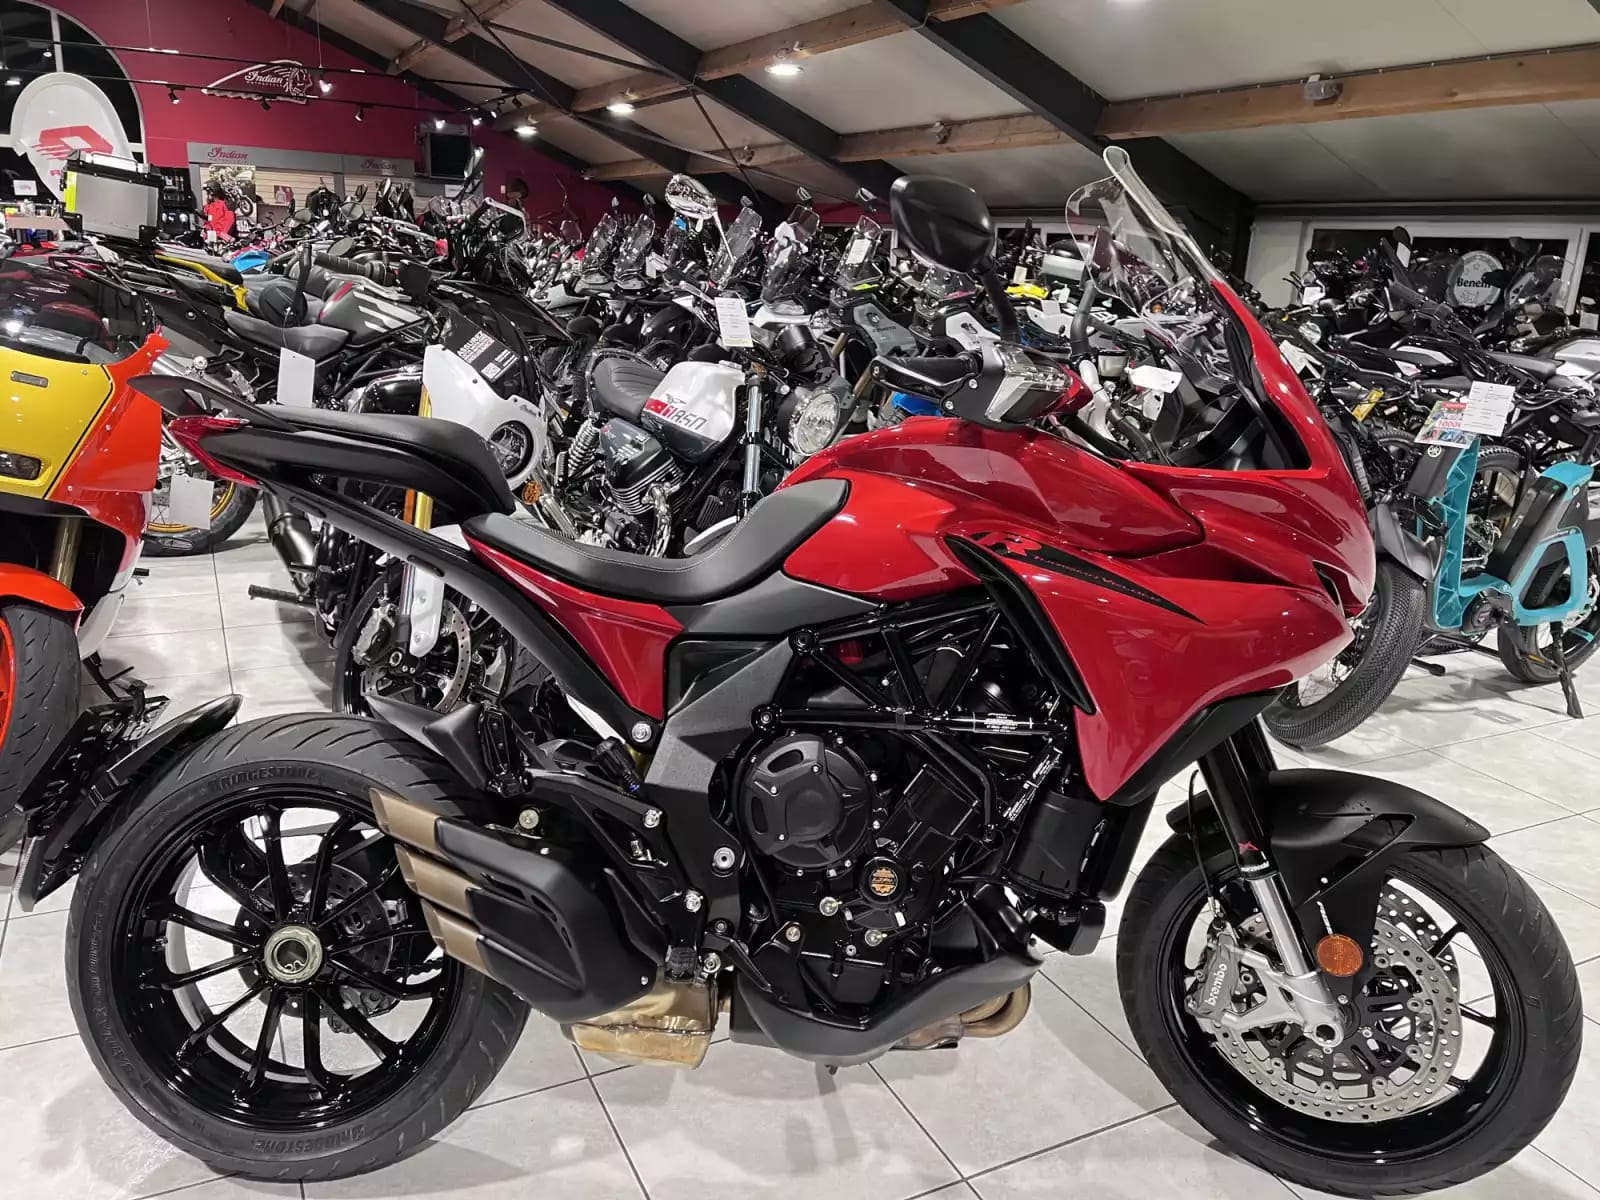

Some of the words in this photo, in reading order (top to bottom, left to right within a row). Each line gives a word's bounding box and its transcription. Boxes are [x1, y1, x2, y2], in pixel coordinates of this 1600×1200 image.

[244, 71, 283, 84] Indian
[208, 146, 248, 160] Indian
[1204, 963, 1228, 1007] brembo
